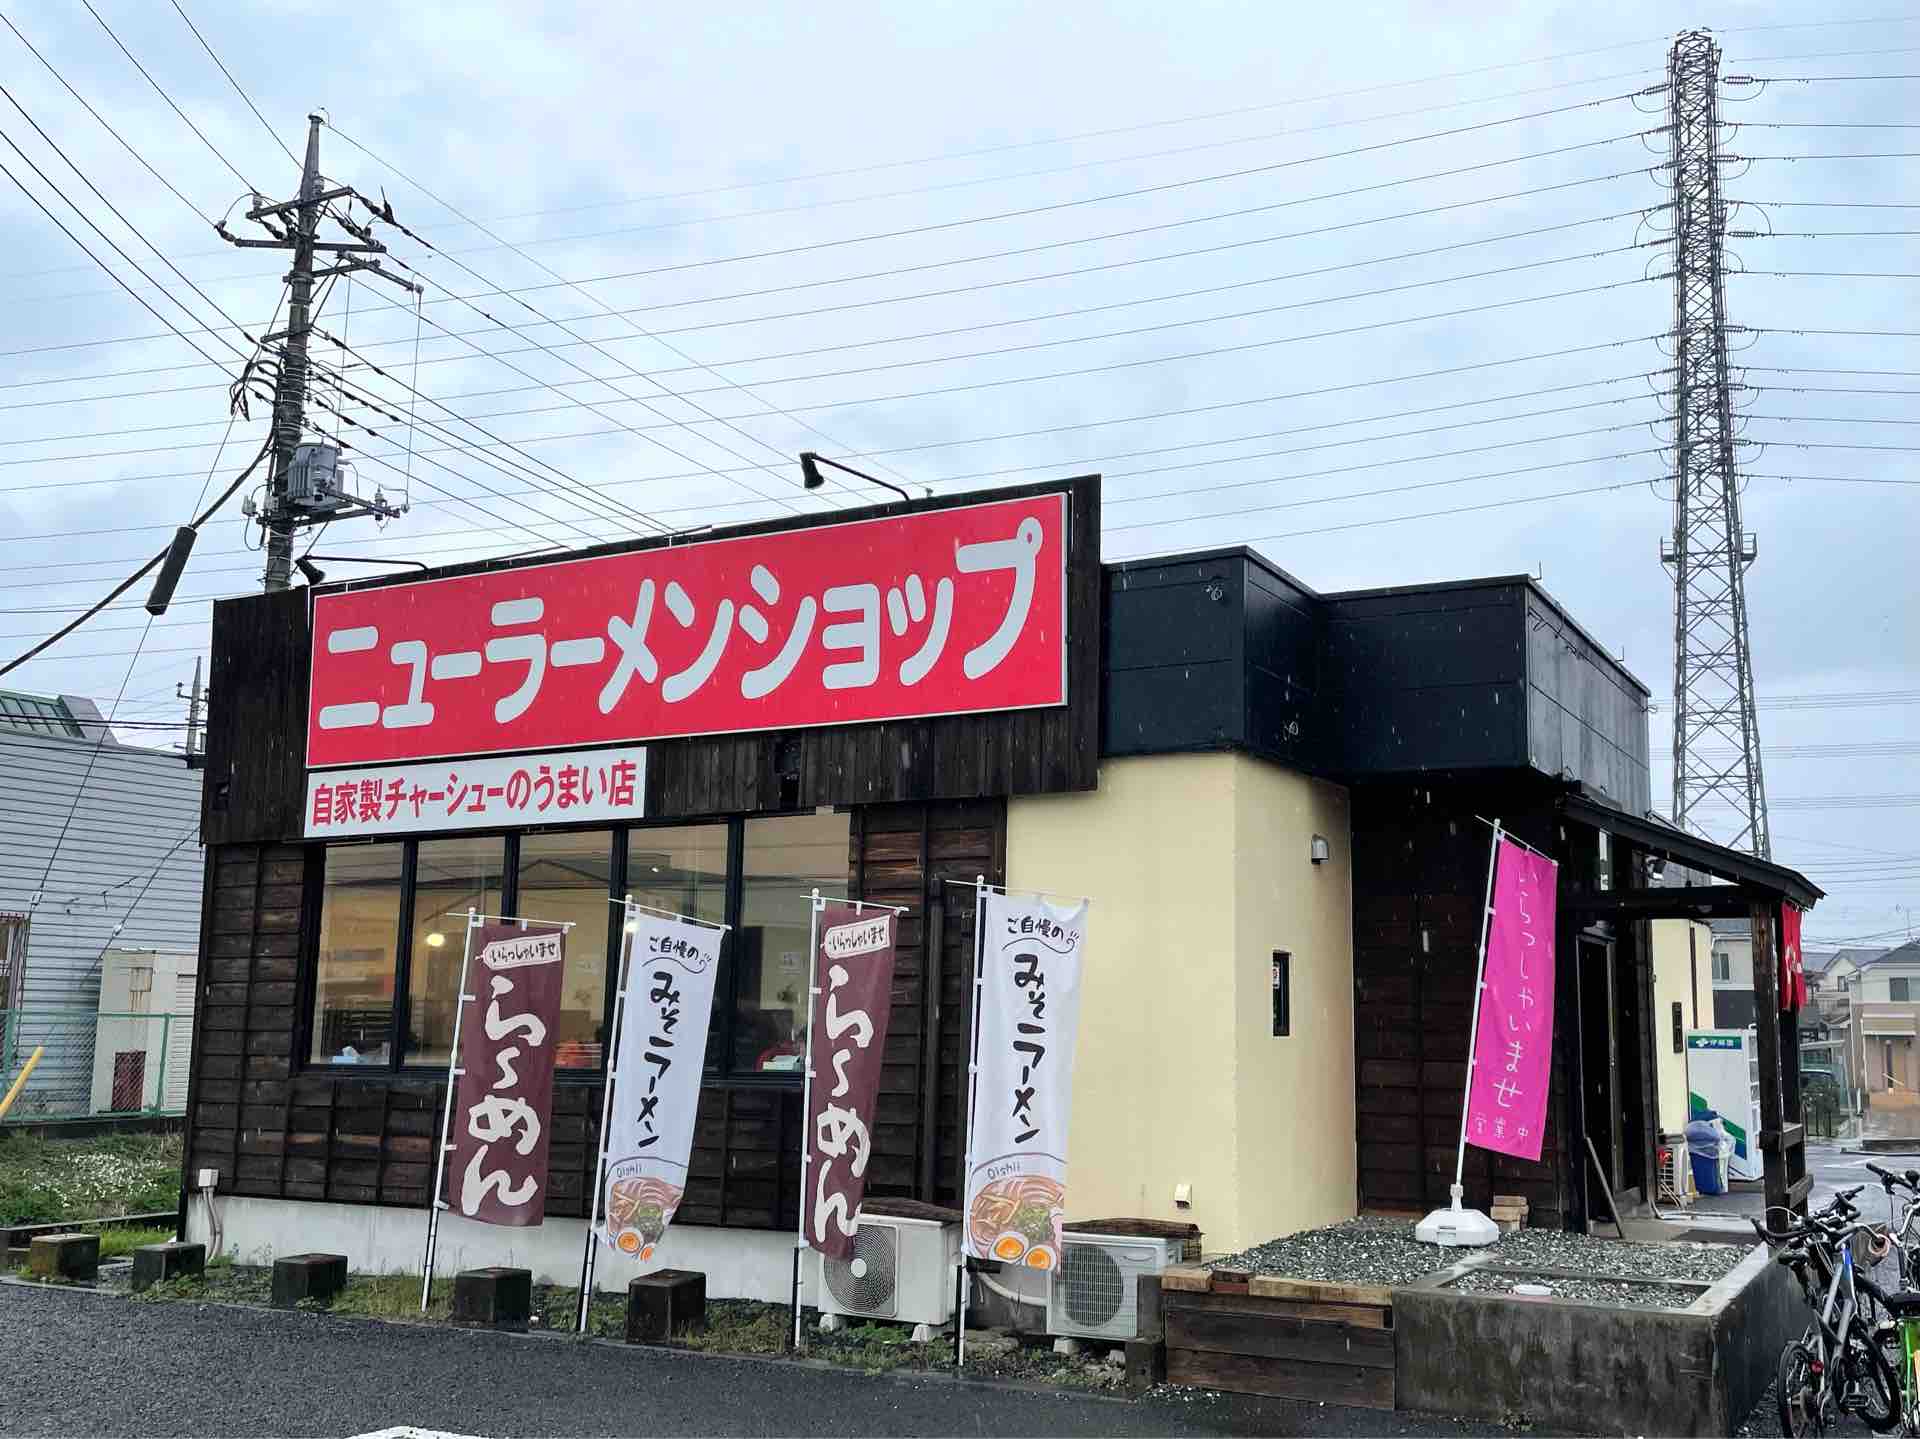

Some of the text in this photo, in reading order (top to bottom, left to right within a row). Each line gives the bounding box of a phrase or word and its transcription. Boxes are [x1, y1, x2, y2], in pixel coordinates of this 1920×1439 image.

[320, 517, 1043, 729] ニューラーメンショップ
[312, 759, 637, 826] 自家製チャーシューのうまい店
[491, 942, 556, 963] いらっしゃいませ
[649, 936, 698, 961] ご自慢の
[833, 925, 884, 951] いらっしゃいませ
[1007, 916, 1064, 940] ご自慢の
[1493, 870, 1538, 1108] いらっしゃいませ
[637, 970, 680, 1149] みそラーメン
[1012, 953, 1046, 1144] みそラーメン
